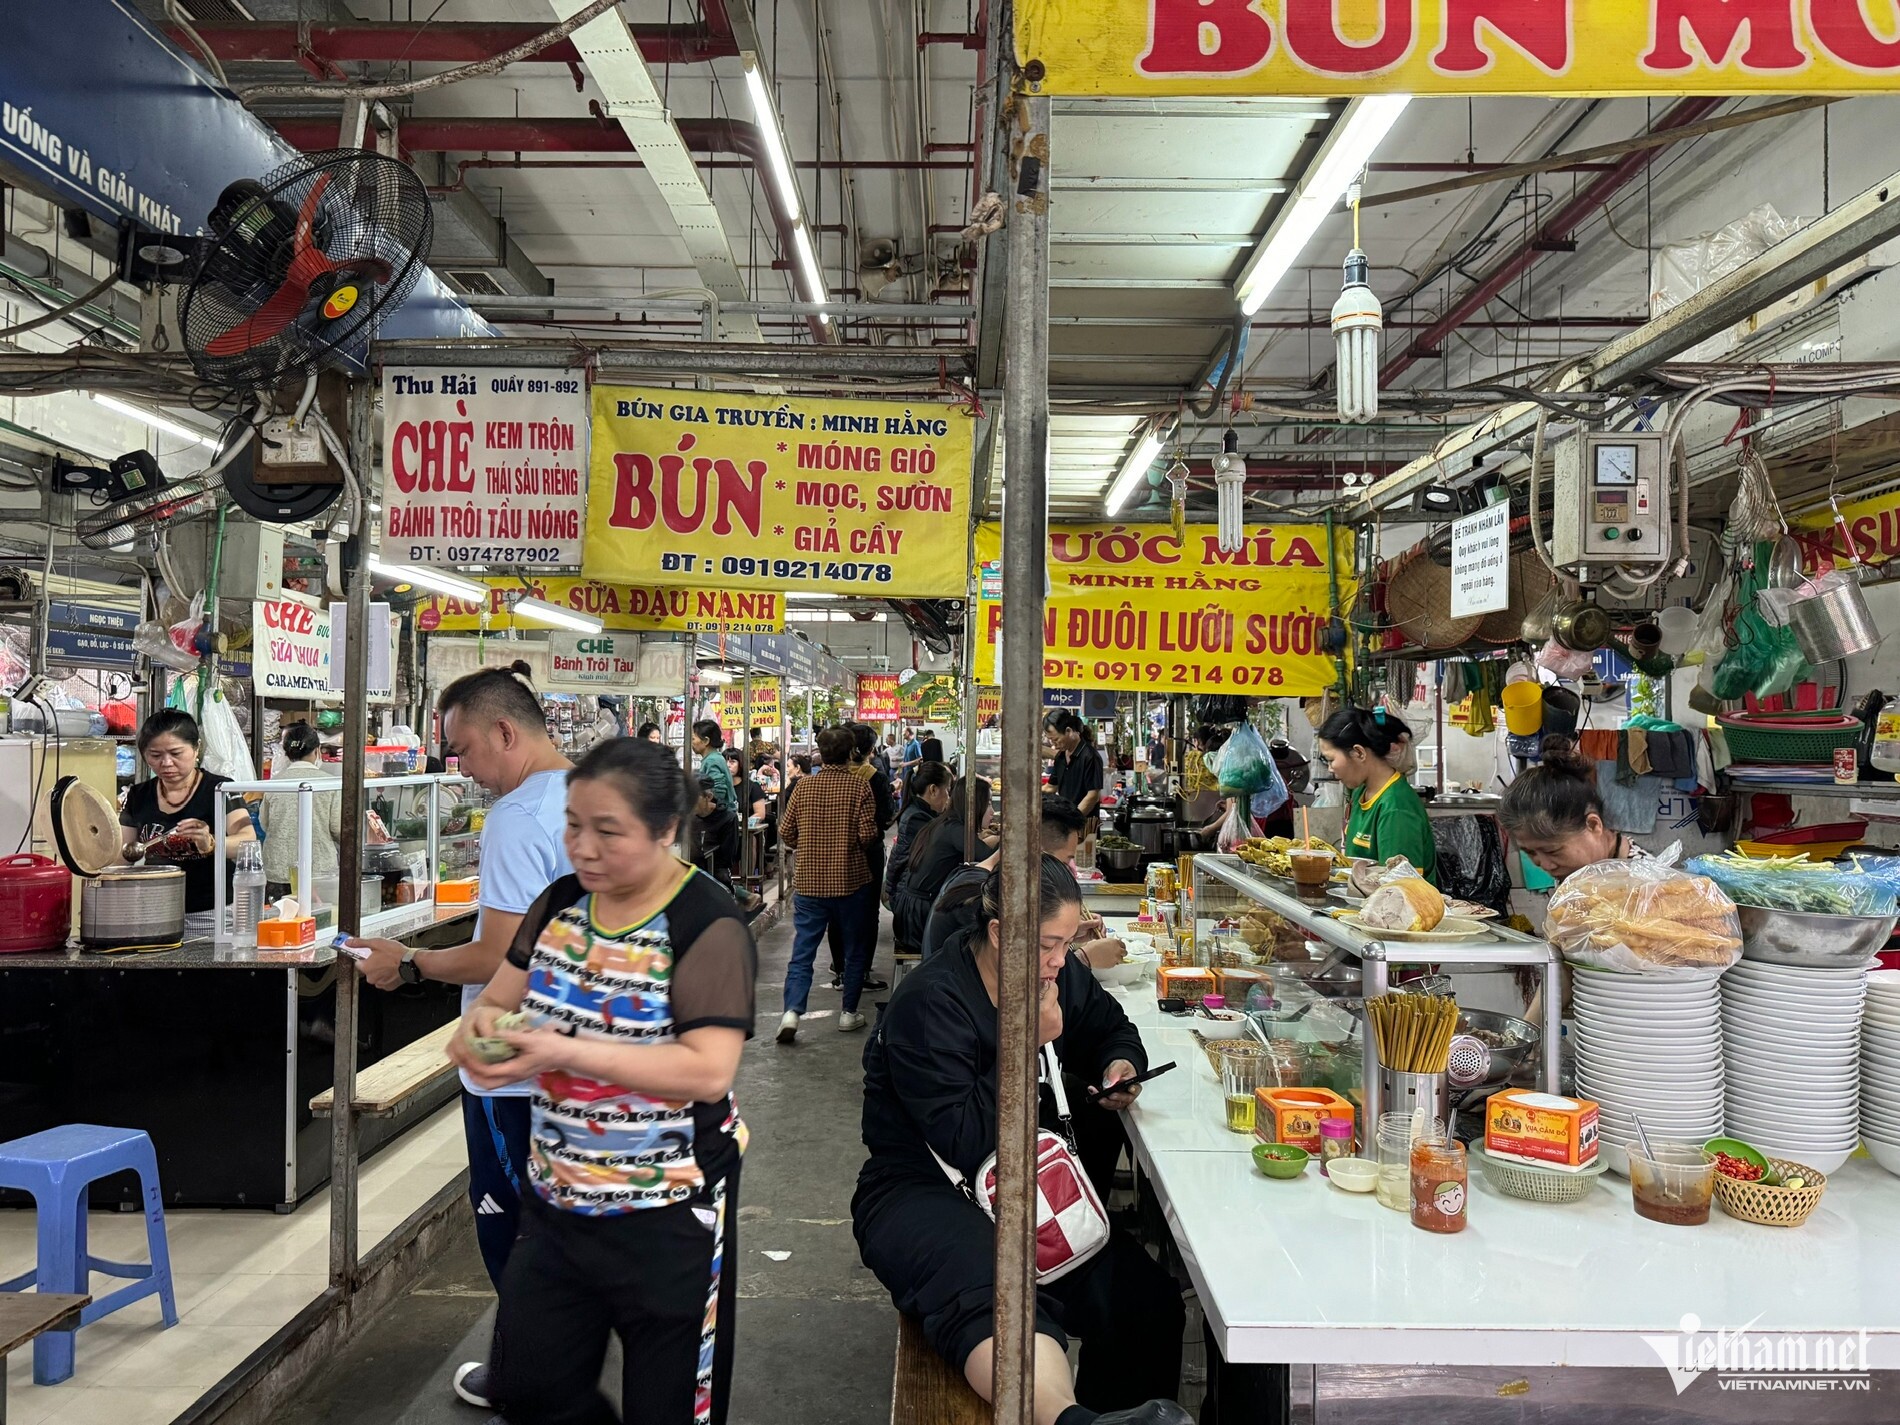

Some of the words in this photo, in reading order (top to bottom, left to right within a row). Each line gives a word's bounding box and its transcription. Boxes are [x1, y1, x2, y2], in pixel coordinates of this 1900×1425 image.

[3, 102, 62, 165] UỐNG
[67, 145, 92, 185] VÀ
[98, 167, 135, 212] GIẢI
[139, 193, 181, 236] KHÁT
[392, 375, 434, 395] Thu
[440, 373, 477, 395] Hải
[491, 375, 524, 393] QUẦY
[527, 380, 579, 394] 891-892
[616, 397, 663, 420] BÚN
[669, 405, 709, 424] GIA
[715, 403, 805, 431] TRUYỀN
[822, 414, 879, 433] MINH
[884, 408, 948, 437] HẰNG
[392, 399, 475, 494] CHÈ
[485, 421, 523, 449] KEM
[528, 416, 574, 457] TRỘN
[796, 440, 881, 472] MÓNG
[890, 443, 936, 475] GIÒ
[485, 461, 511, 495] THÁI
[515, 457, 539, 496] SẦU
[542, 462, 578, 496] RIÊNG
[608, 432, 768, 538] BÚN
[795, 481, 867, 513] MỌC,
[876, 479, 953, 513] SƯỜN
[388, 500, 435, 537] BÁNH
[440, 501, 481, 538] TRÔI
[487, 497, 522, 540] TẦU
[527, 503, 579, 540] NÓNG
[1462, 520, 1478, 538] TRÁNH
[794, 517, 840, 553] GIẢ
[850, 521, 903, 555] CẦY
[1049, 526, 1182, 565] ƯỚC
[1201, 528, 1326, 567] MÍA
[409, 546, 441, 561] ĐT:
[447, 546, 560, 562] 0974787902
[662, 553, 696, 573] ĐT
[721, 556, 892, 582] 0919214078
[1068, 574, 1155, 588] MINH
[1164, 570, 1262, 592] HẰNG
[568, 581, 622, 616] SỮA
[629, 588, 690, 623] ĐẬU
[89, 613, 107, 625] NGỌC
[107, 615, 124, 627] THIỆU
[687, 622, 703, 630] ĐT:
[755, 624, 774, 632] 078
[1068, 601, 1149, 650] ĐUÔI
[1159, 603, 1235, 652] LƯỠI
[270, 637, 293, 662] SỮA
[294, 645, 319, 667] HUA
[577, 637, 614, 654] CHÈ
[554, 655, 582, 671] Bánh
[586, 657, 609, 672] Trôi
[613, 658, 634, 673] Tàu
[1044, 660, 1084, 680] ĐT:
[1093, 662, 1162, 682] 0919
[1172, 664, 1223, 684] 214
[1232, 666, 1284, 686] 078
[724, 688, 742, 704] BÁNH
[757, 688, 776, 703] NÓNG
[724, 706, 739, 715] SỮA
[977, 696, 999, 711] ÁNH
[728, 718, 742, 726] TÀ
